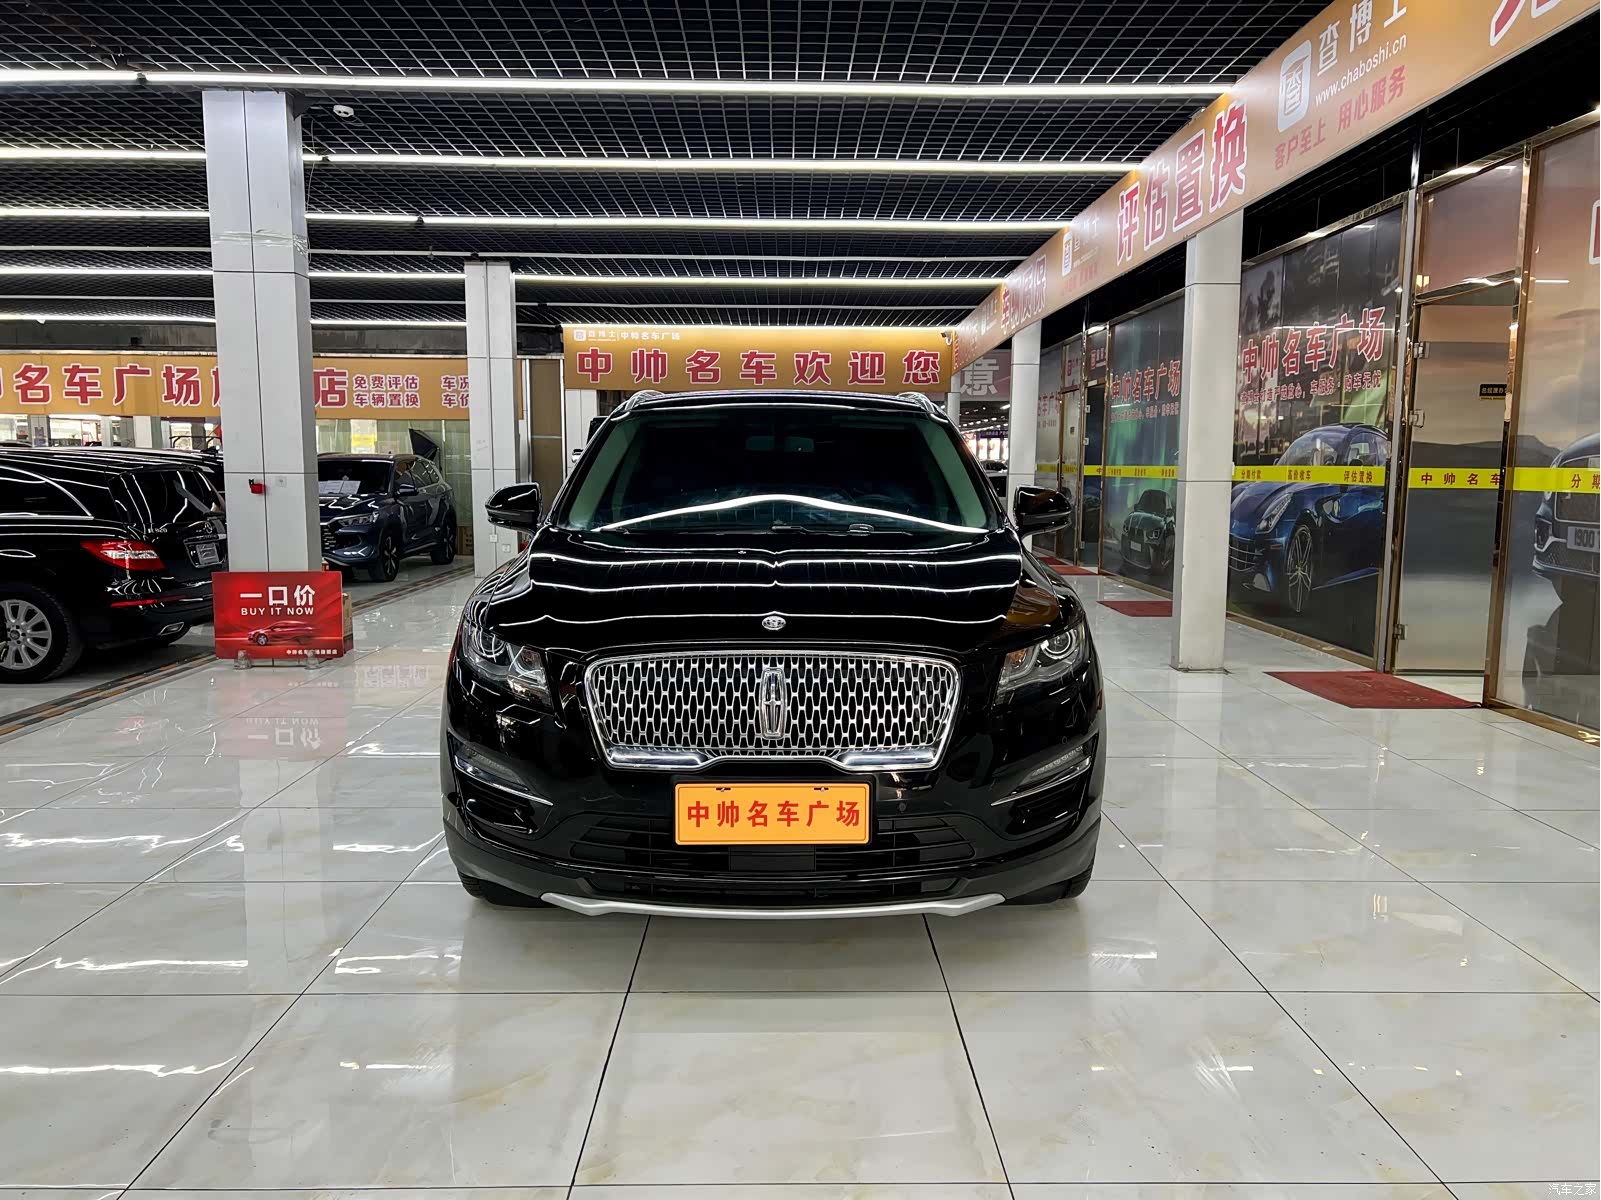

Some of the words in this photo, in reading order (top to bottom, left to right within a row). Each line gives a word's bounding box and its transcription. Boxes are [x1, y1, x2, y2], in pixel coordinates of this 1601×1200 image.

[1314, 34, 1407, 107] www.chaboshi.cn
[1274, 117, 1327, 171] 客户至上
[1337, 64, 1406, 135] 用心服务
[1116, 99, 1248, 267] 评估置换
[1241, 306, 1386, 385] 中帅名车广场
[576, 346, 941, 387] 中帅名车欢迎您
[353, 374, 419, 391] 免费评估
[354, 392, 421, 408] 车辆置换
[1343, 470, 1373, 484] 评估置换
[1420, 472, 1500, 486] 中帅名车
[240, 584, 316, 606] 一口价
[241, 607, 266, 616] BUY
[270, 607, 282, 616] IT
[286, 607, 314, 616] NOW
[686, 800, 861, 828] 中帅名车广场
